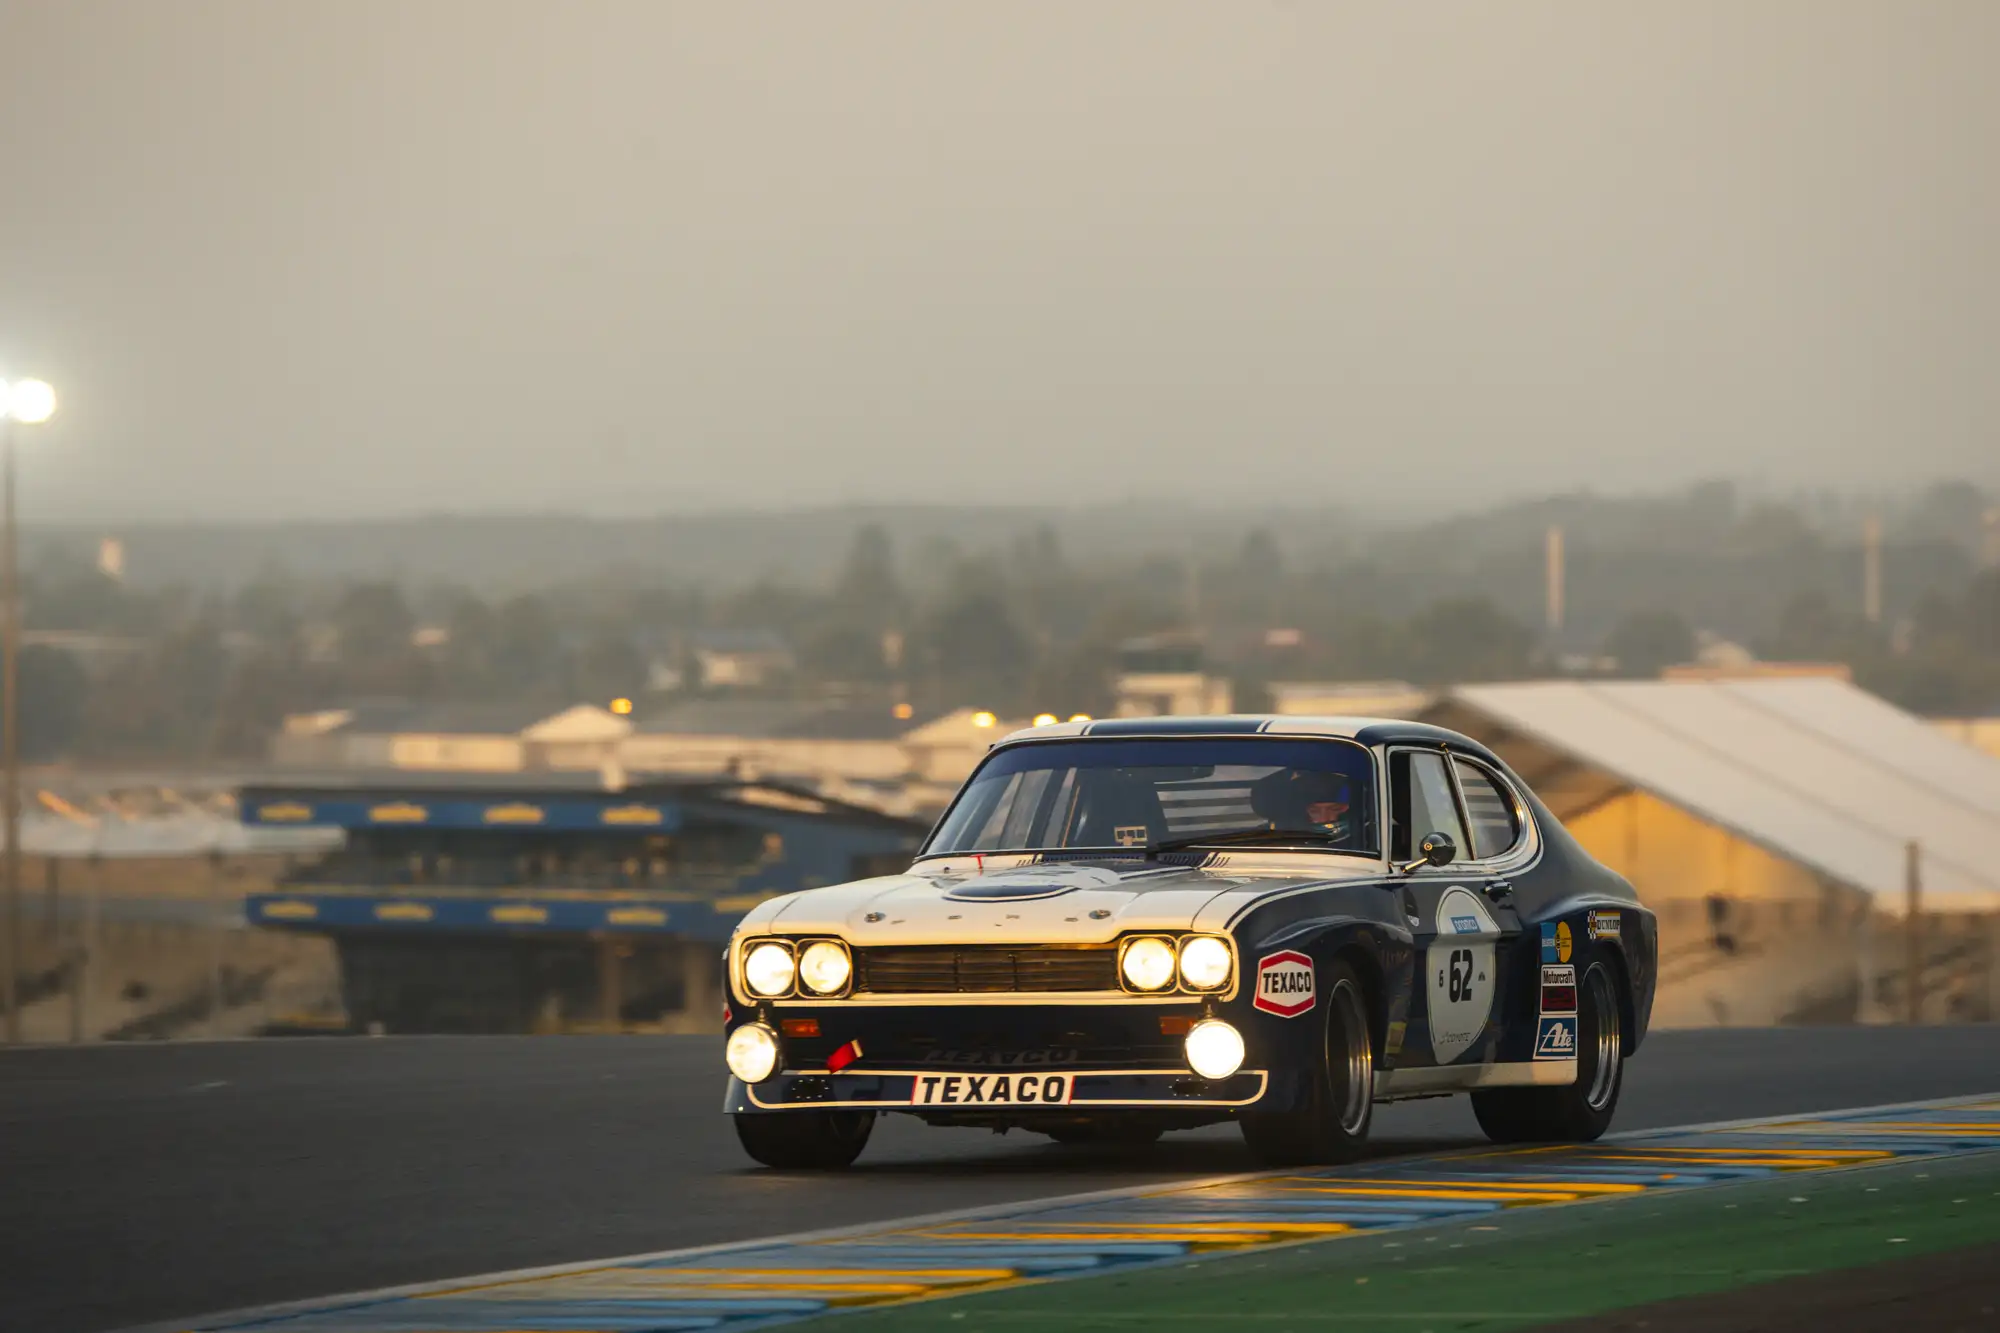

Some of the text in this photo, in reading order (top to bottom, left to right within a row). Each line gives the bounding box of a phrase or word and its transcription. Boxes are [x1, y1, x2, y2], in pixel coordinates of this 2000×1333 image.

[1597, 919, 1620, 930] DUNLOP
[1263, 971, 1311, 993] TEXACO
[1449, 949, 1473, 1003] 62
[1543, 970, 1573, 984] Motorcraft
[922, 1076, 1065, 1104] TEXACO
